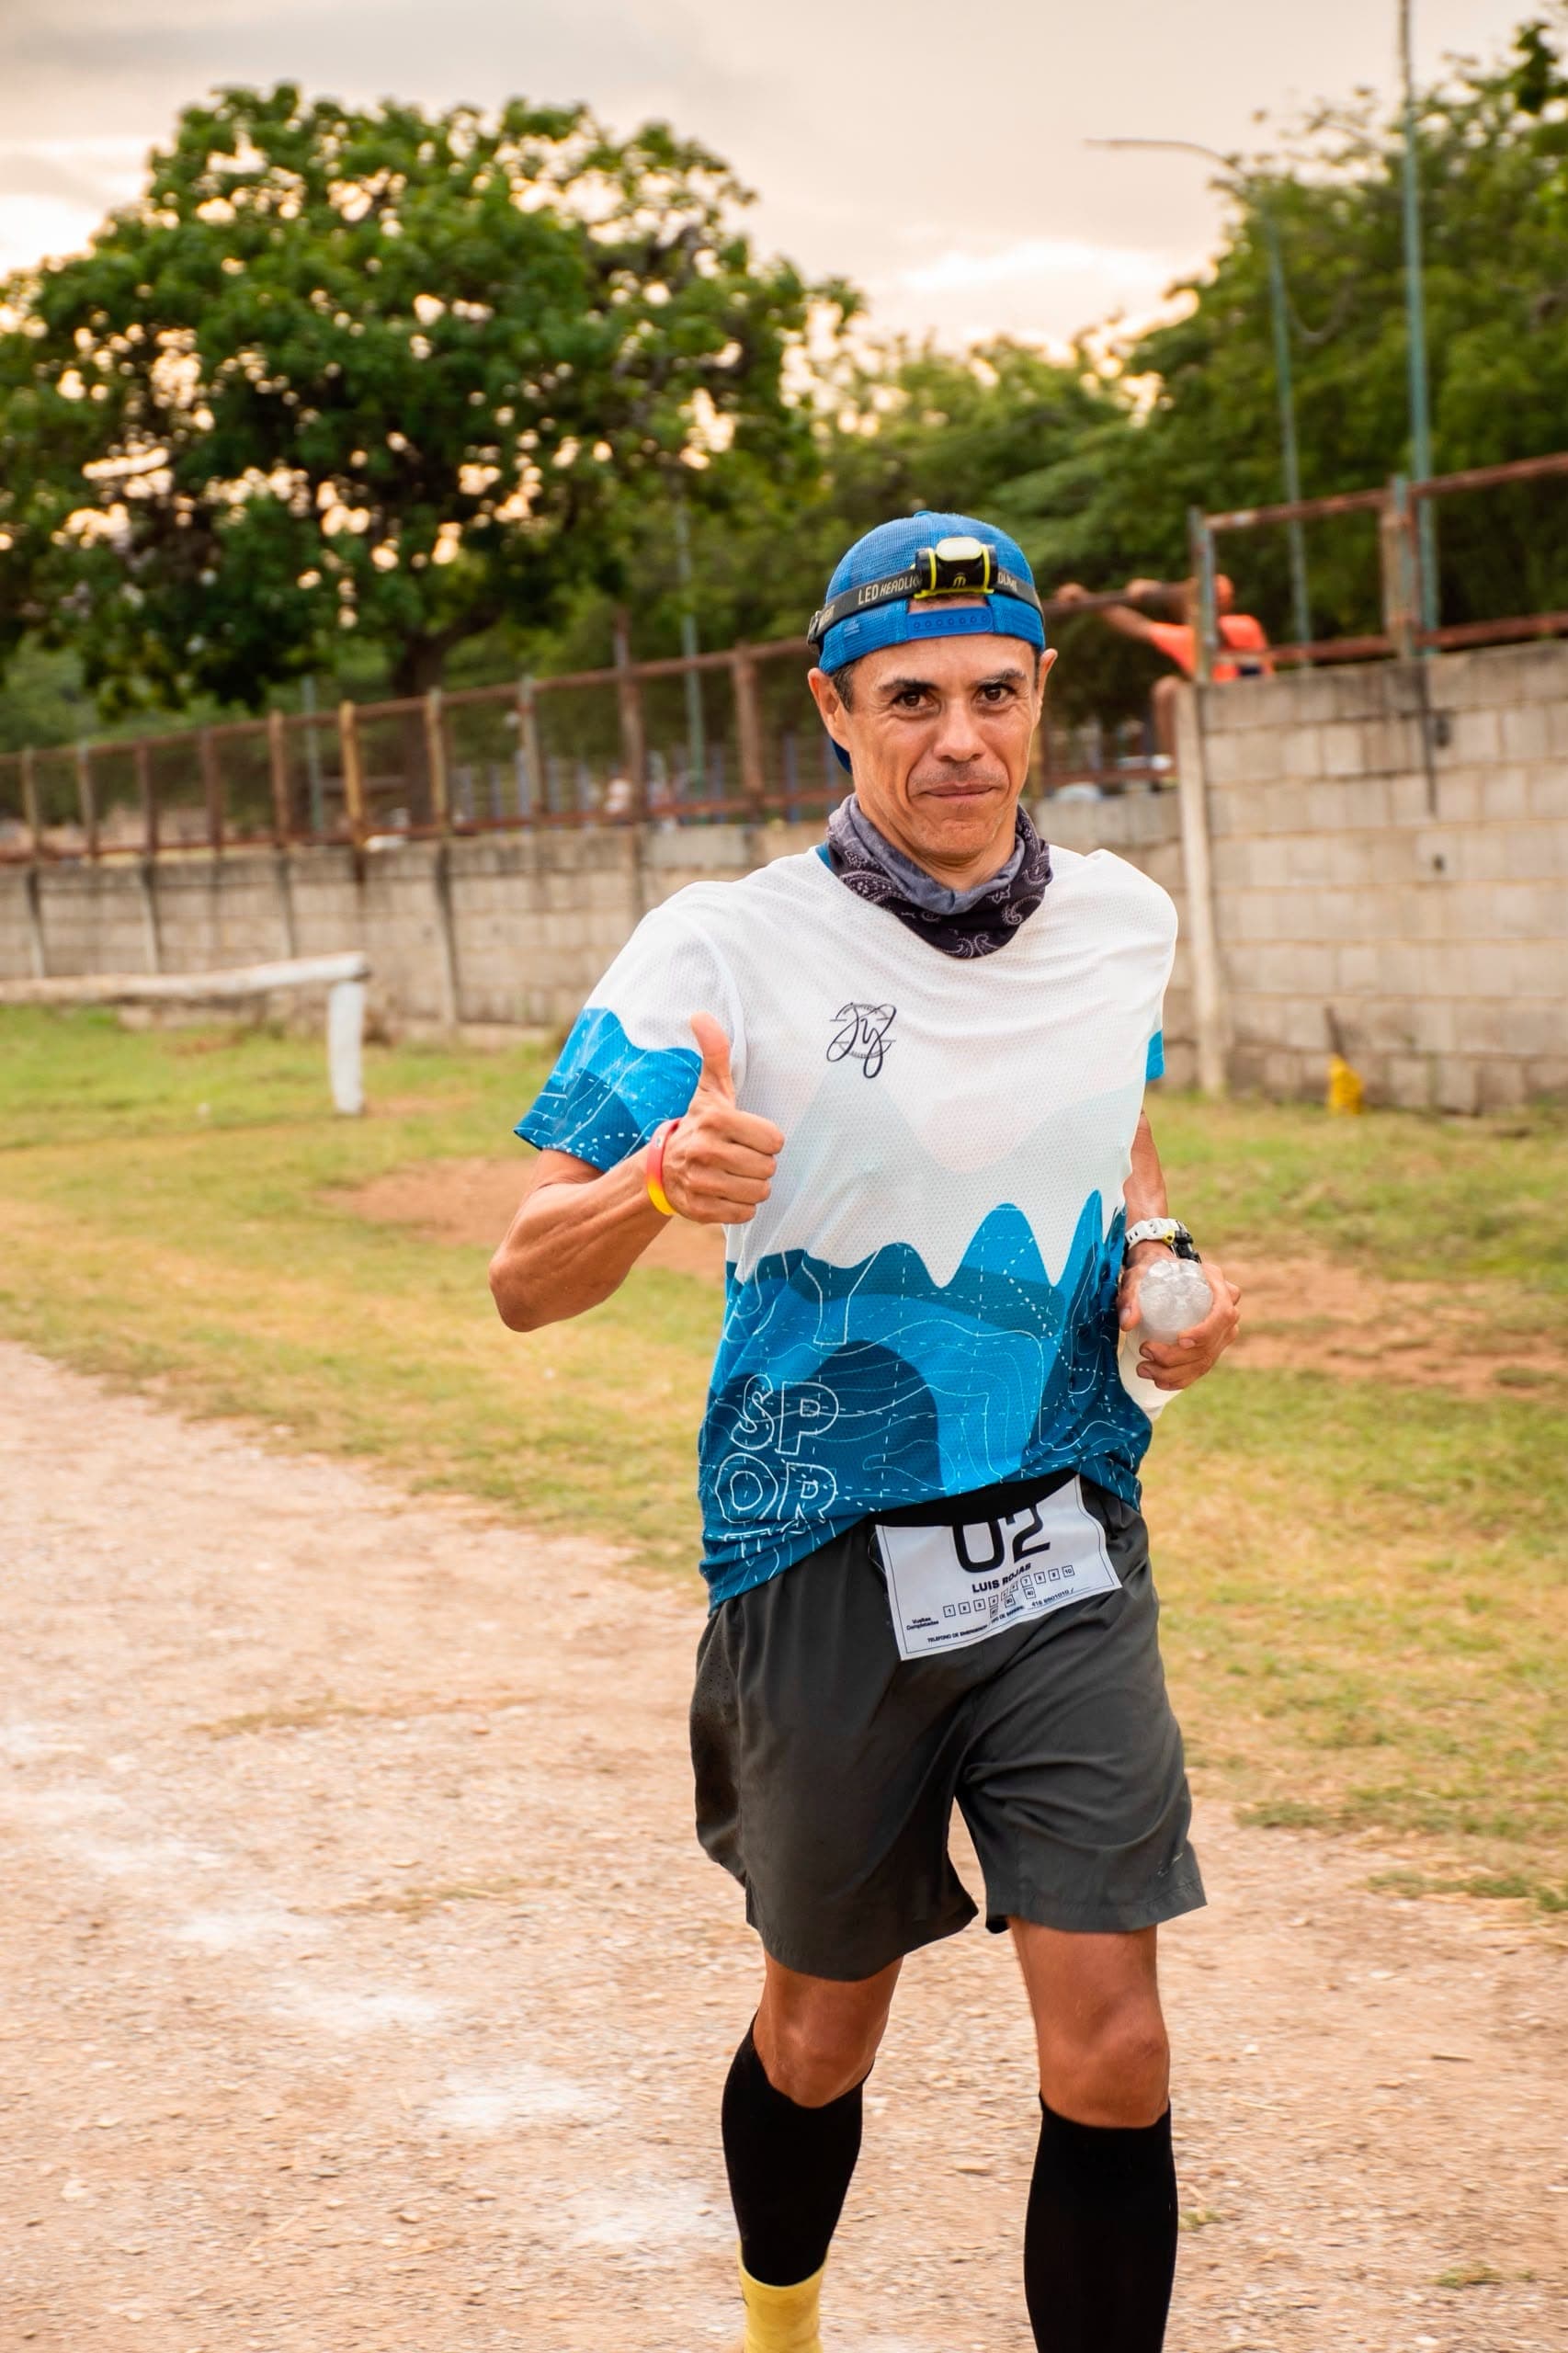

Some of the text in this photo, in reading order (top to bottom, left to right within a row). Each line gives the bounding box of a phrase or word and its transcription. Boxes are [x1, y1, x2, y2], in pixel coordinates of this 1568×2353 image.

[858, 584, 879, 605] LED
[952, 1504, 1051, 1573] 02
[972, 1578, 1001, 1594] LUIS
[1002, 1563, 1032, 1586] ROJAS
